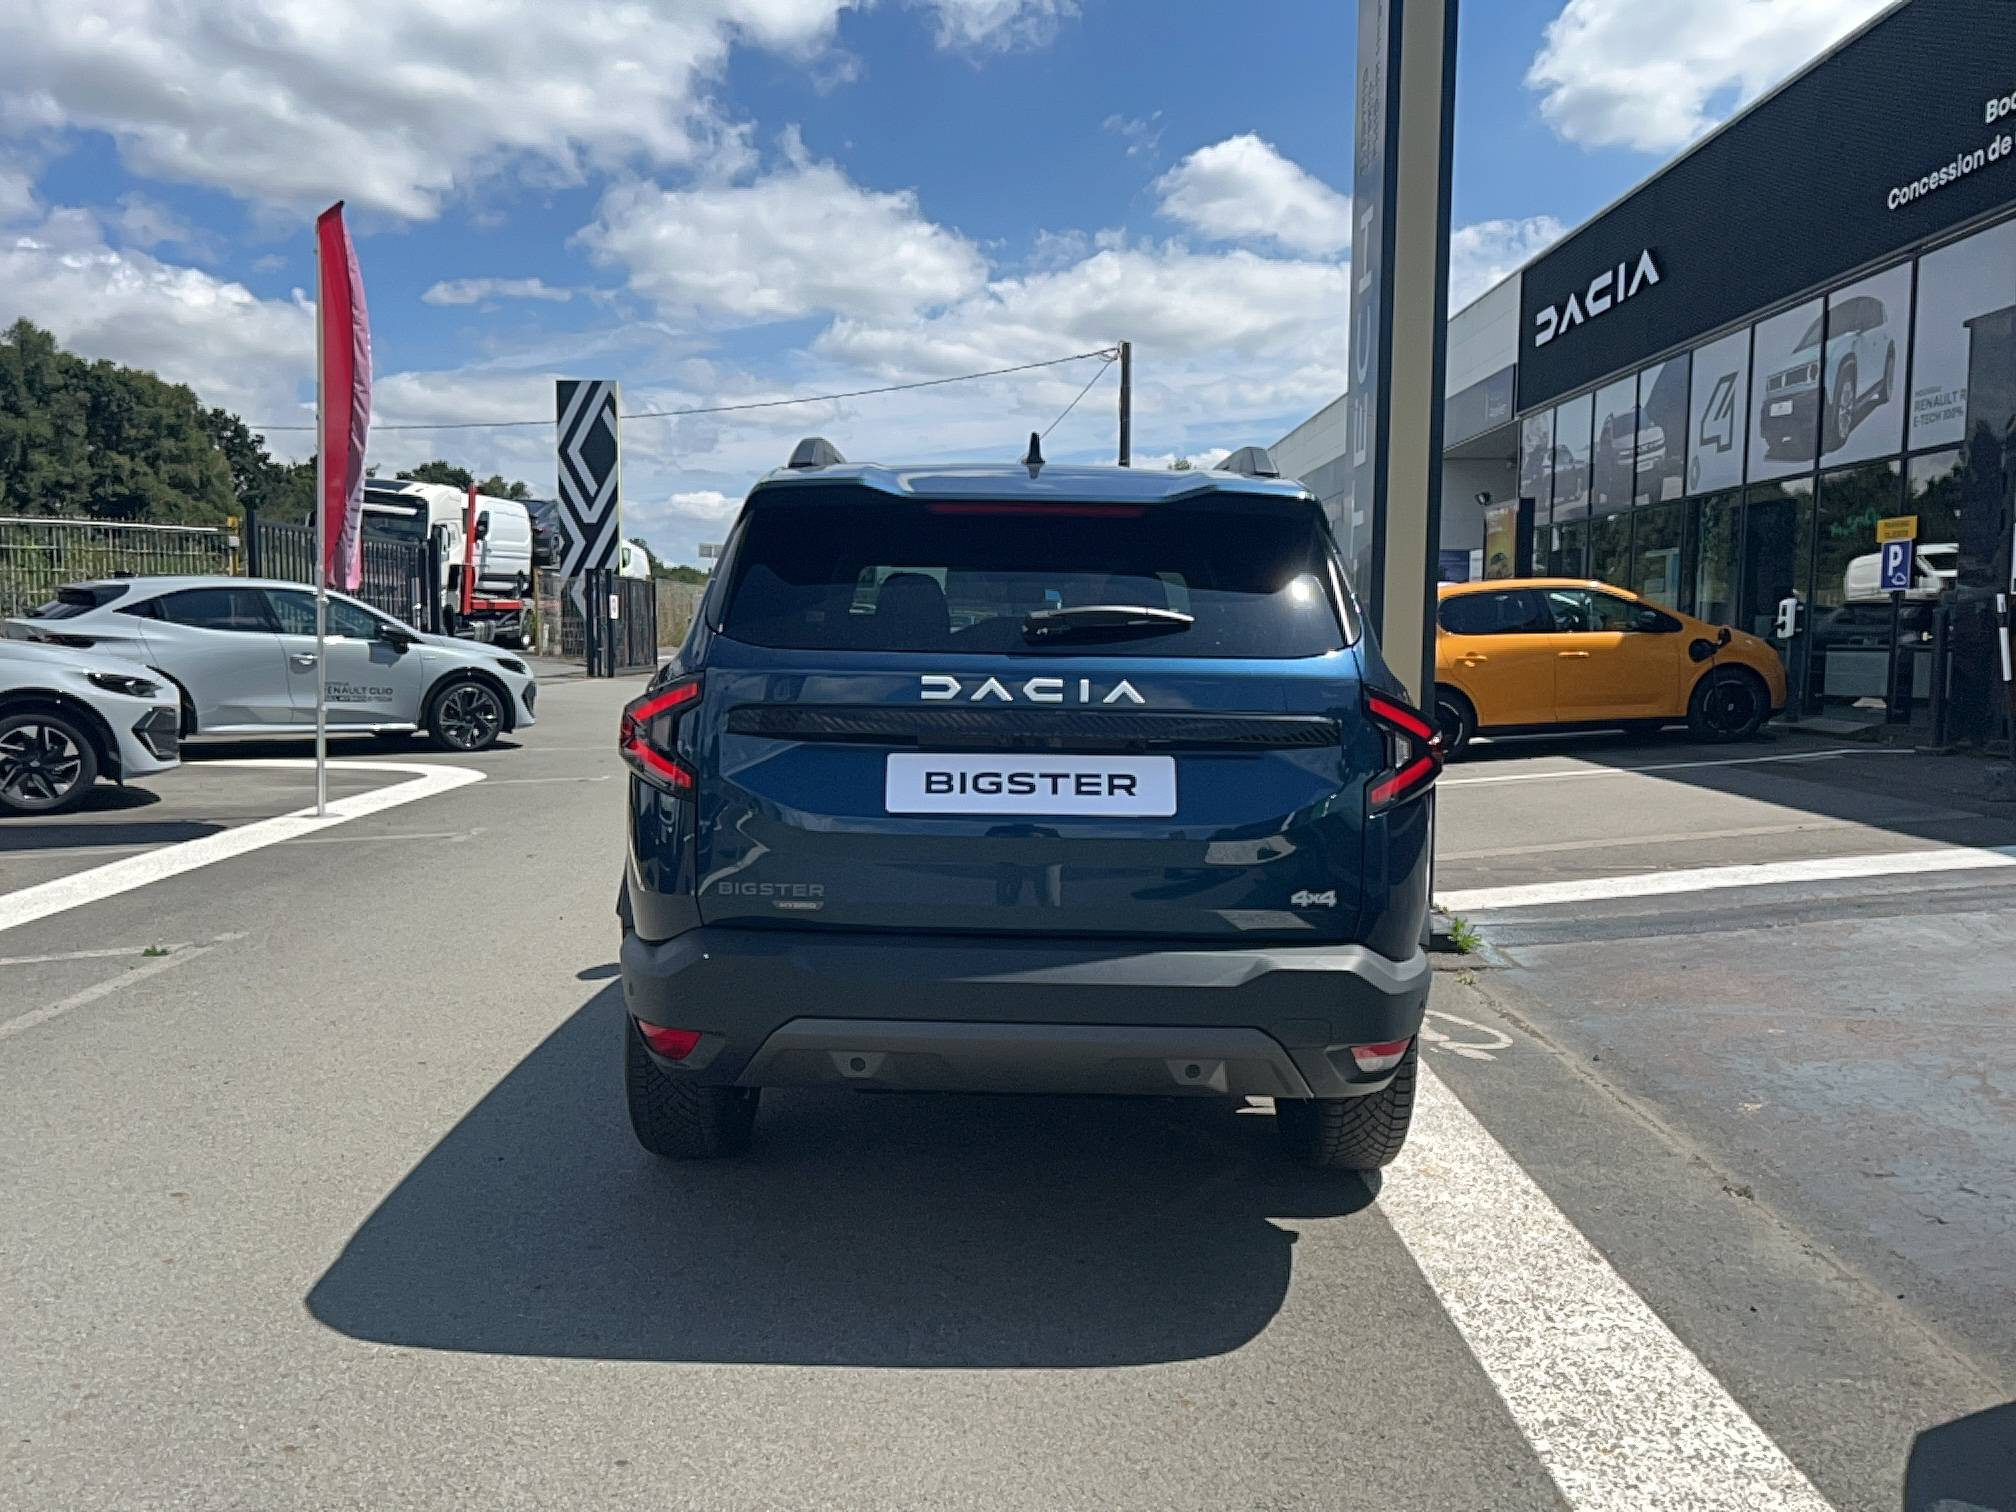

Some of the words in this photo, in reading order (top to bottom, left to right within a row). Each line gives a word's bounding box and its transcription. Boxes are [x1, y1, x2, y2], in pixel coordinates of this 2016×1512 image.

[1887, 148, 1985, 210] Concession
[1987, 134, 2013, 162] de
[1534, 248, 1661, 348] DACIA
[1887, 544, 1904, 577] P
[369, 686, 394, 696] CLIO
[920, 674, 1146, 705] DACIA
[924, 771, 1138, 797] BIGSTER
[717, 881, 826, 897] BIGSTER
[1290, 889, 1338, 908] 4x4
